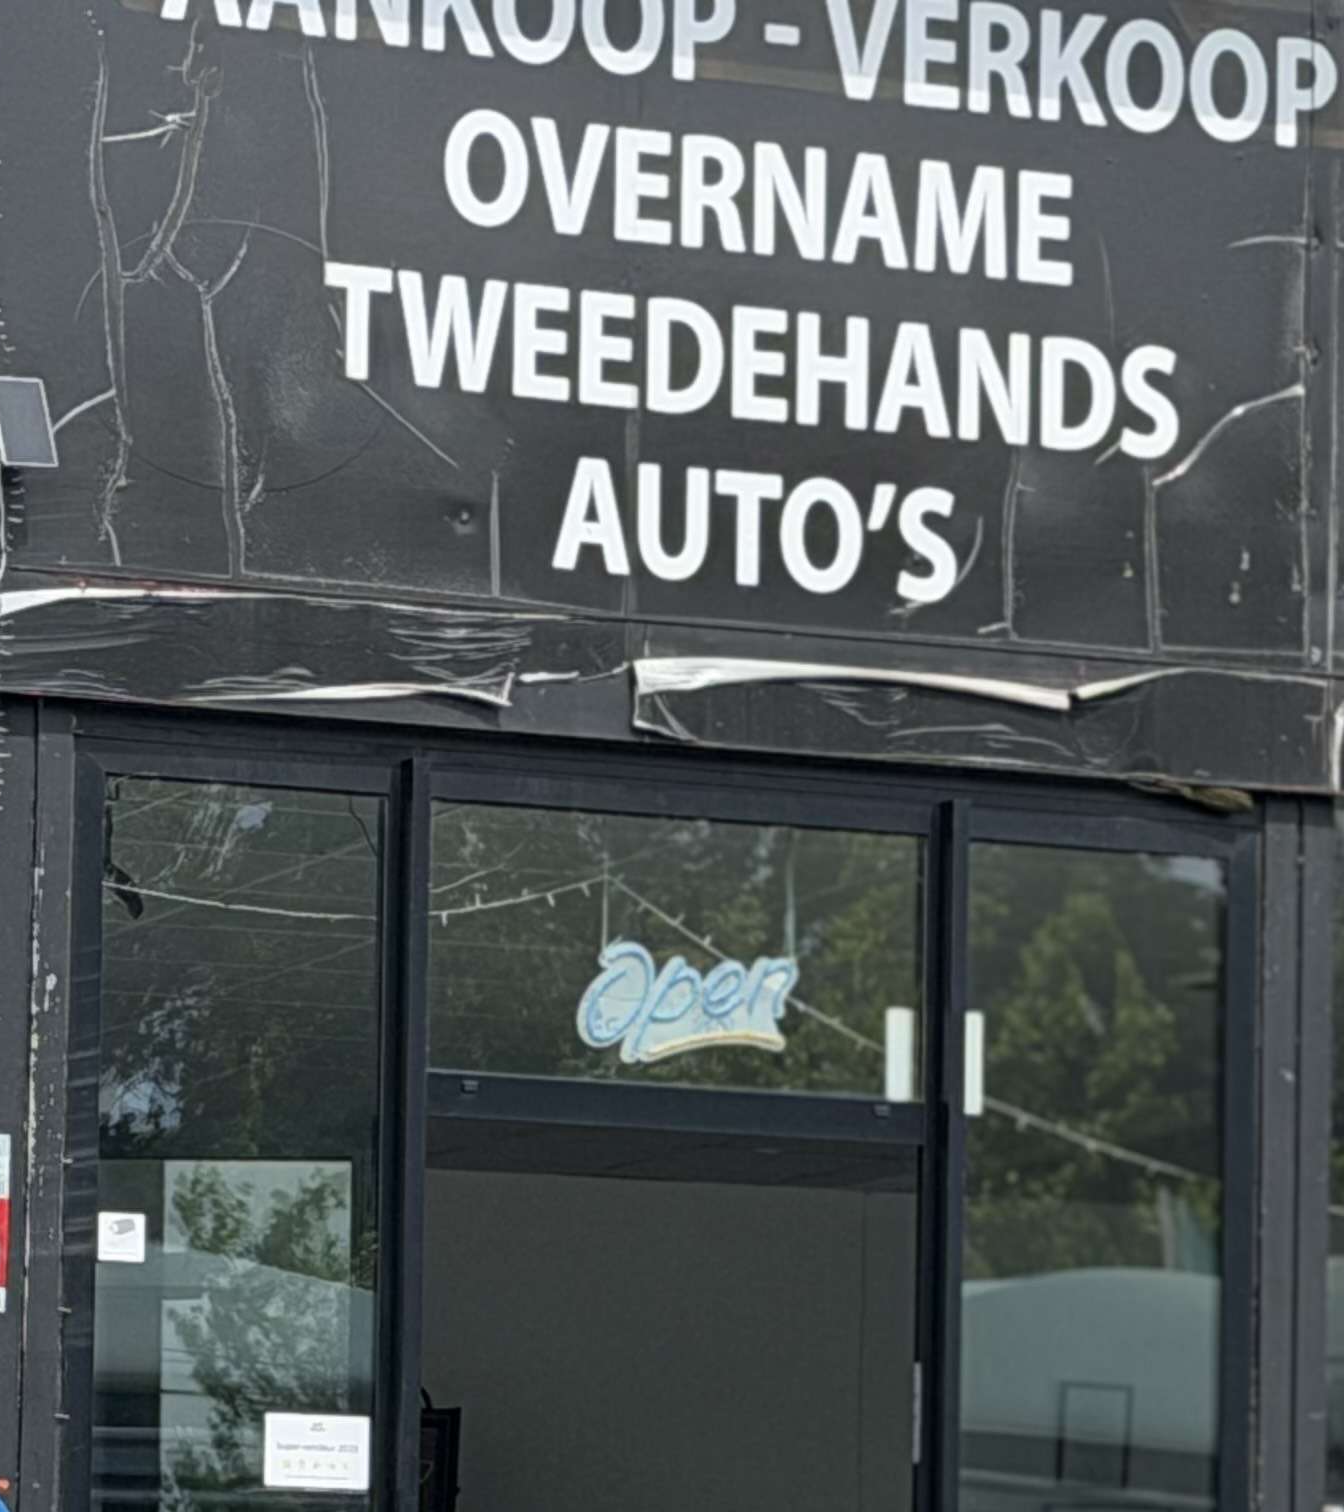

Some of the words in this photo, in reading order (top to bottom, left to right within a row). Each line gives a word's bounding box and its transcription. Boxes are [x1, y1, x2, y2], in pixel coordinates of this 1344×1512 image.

[826, 0, 1338, 147] VERKOOP
[444, 108, 1073, 286] OVERNAME
[324, 261, 1179, 459] TWEEDEHANDS
[551, 457, 958, 604] AUTO'S
[576, 941, 798, 1064] Open
